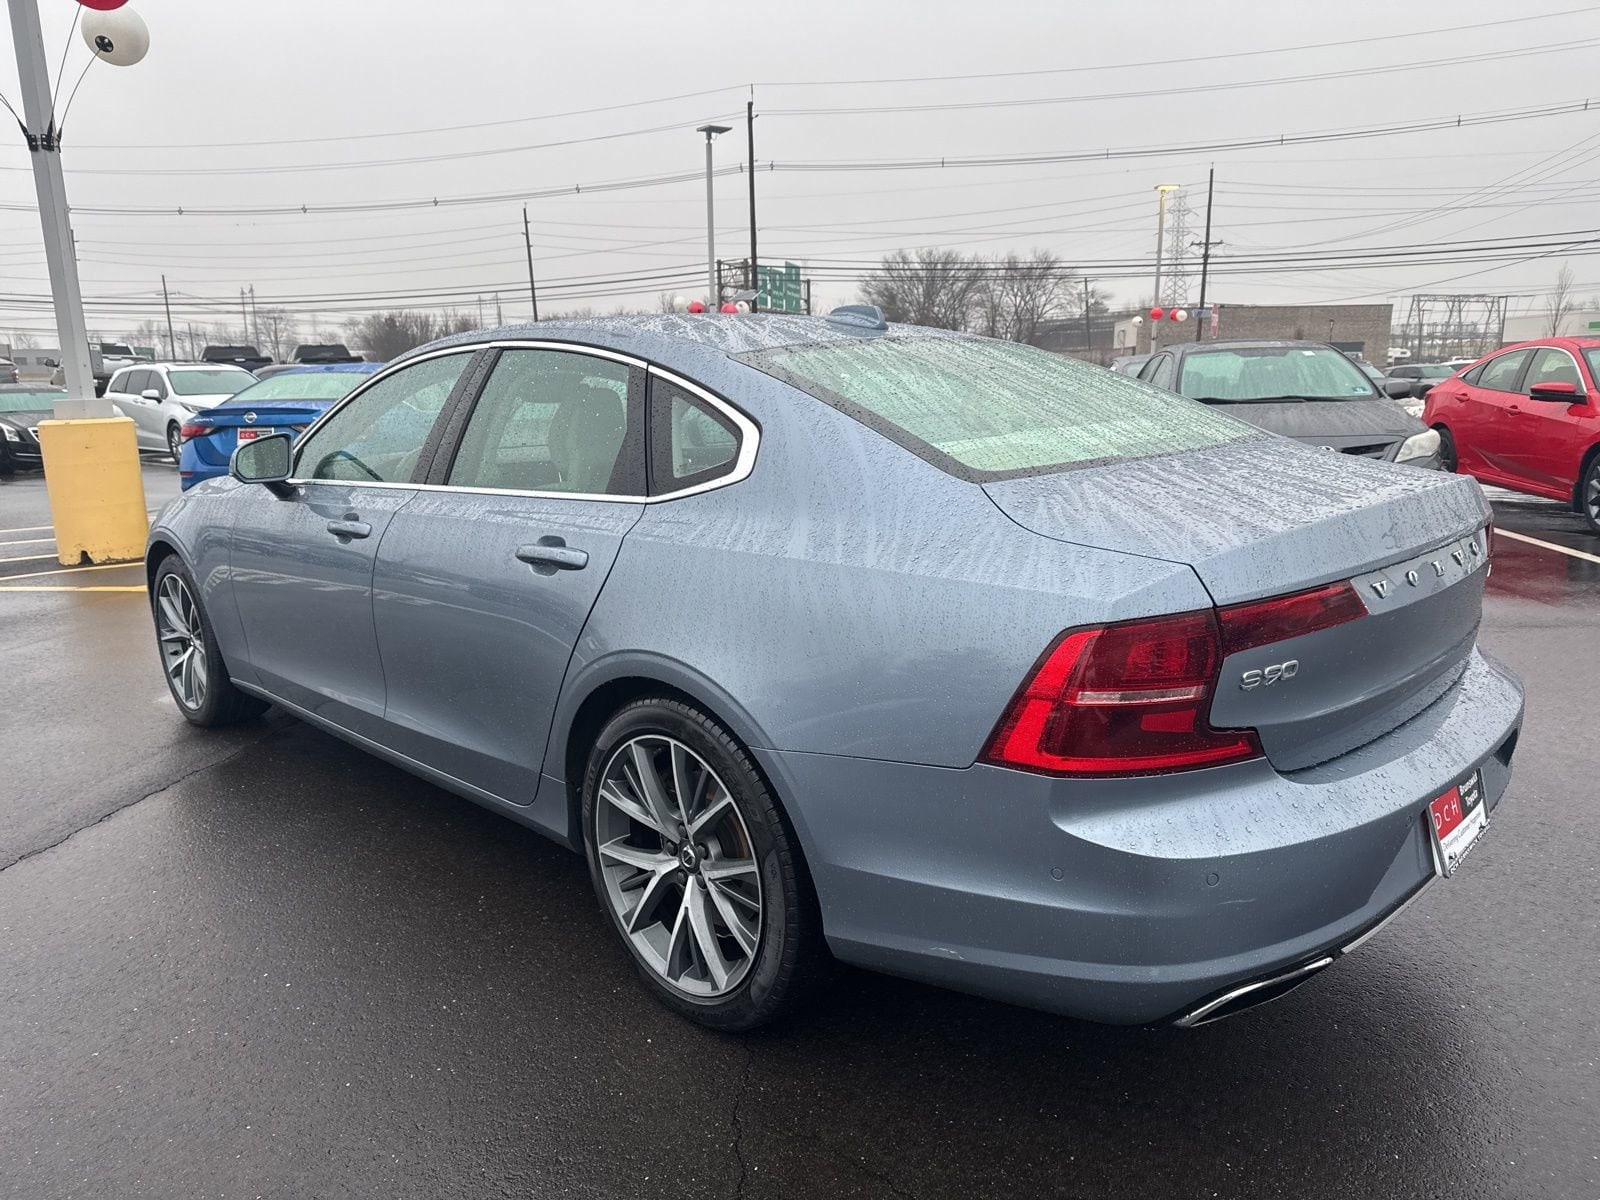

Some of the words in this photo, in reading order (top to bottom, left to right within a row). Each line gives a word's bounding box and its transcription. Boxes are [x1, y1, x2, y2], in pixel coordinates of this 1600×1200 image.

[1371, 541, 1480, 599] VOLVO
[1240, 659, 1299, 691] S90
[1434, 797, 1459, 831] DCH
